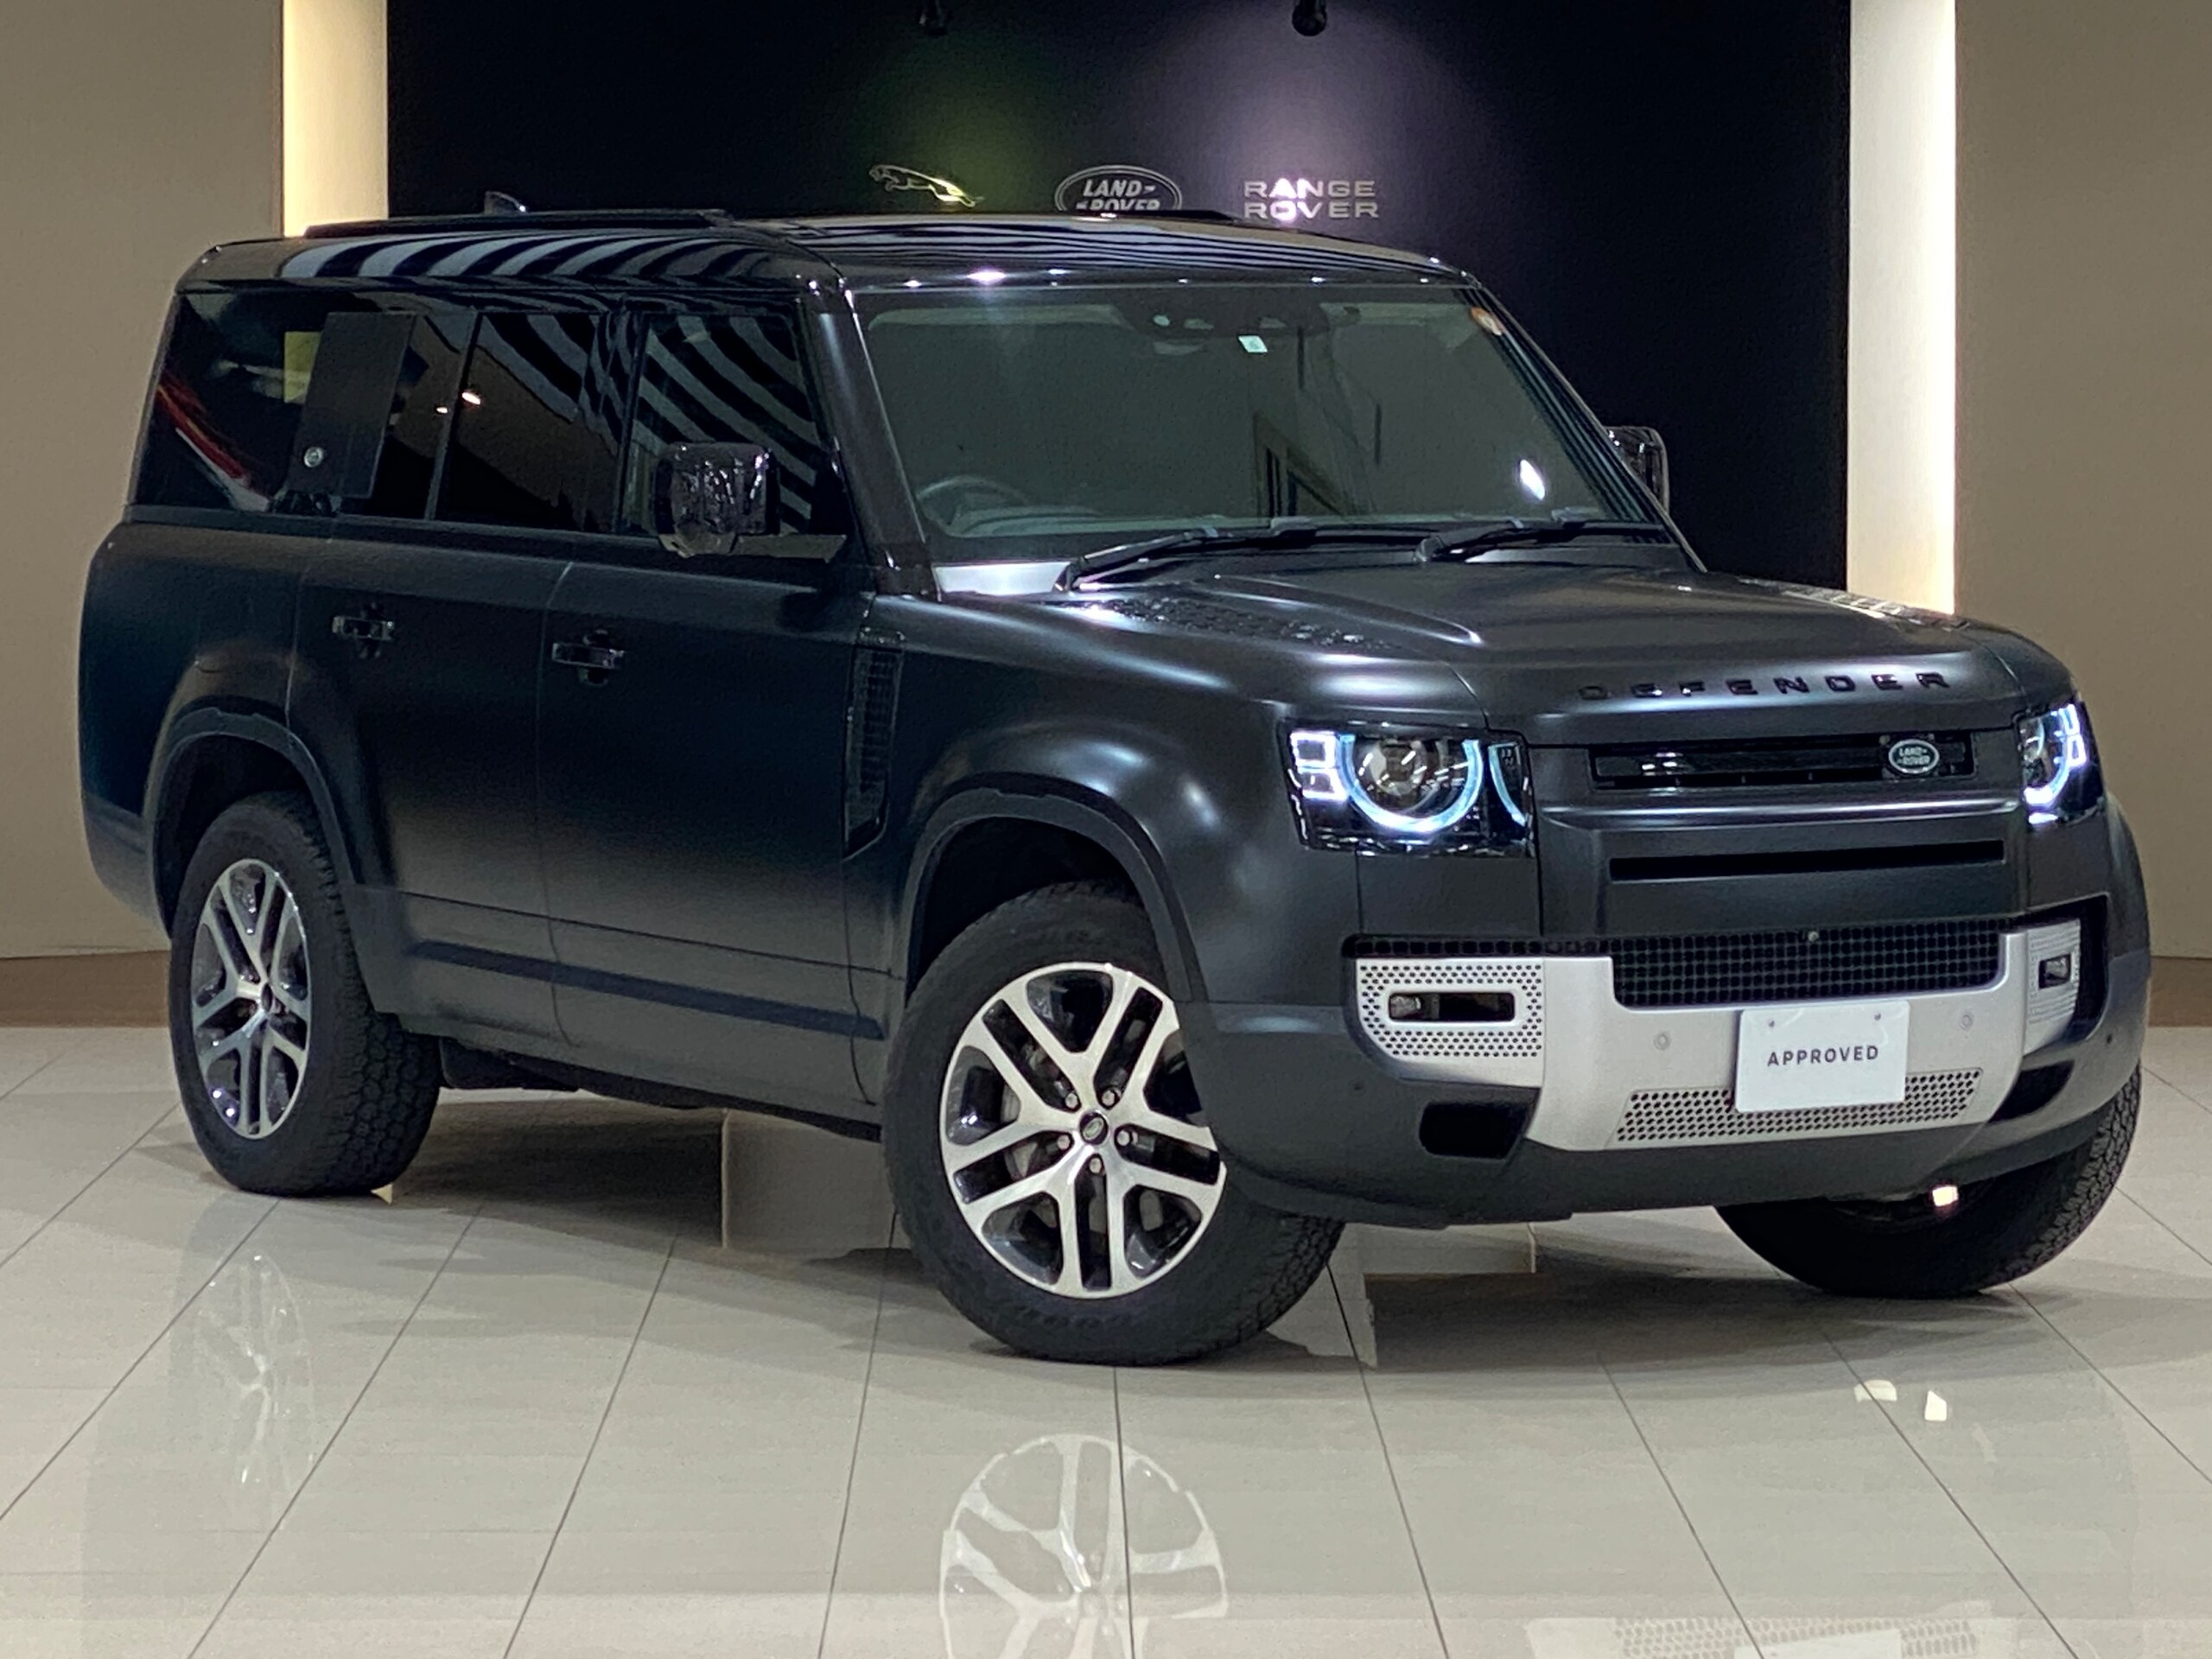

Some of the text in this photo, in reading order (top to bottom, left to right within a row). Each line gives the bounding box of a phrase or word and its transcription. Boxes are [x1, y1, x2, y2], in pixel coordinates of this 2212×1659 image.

[1243, 177, 1376, 199] RANGE
[1243, 200, 1379, 223] ROVER
[1578, 671, 1951, 701] DEFENDER
[1766, 1044, 1879, 1067] APPROVED
